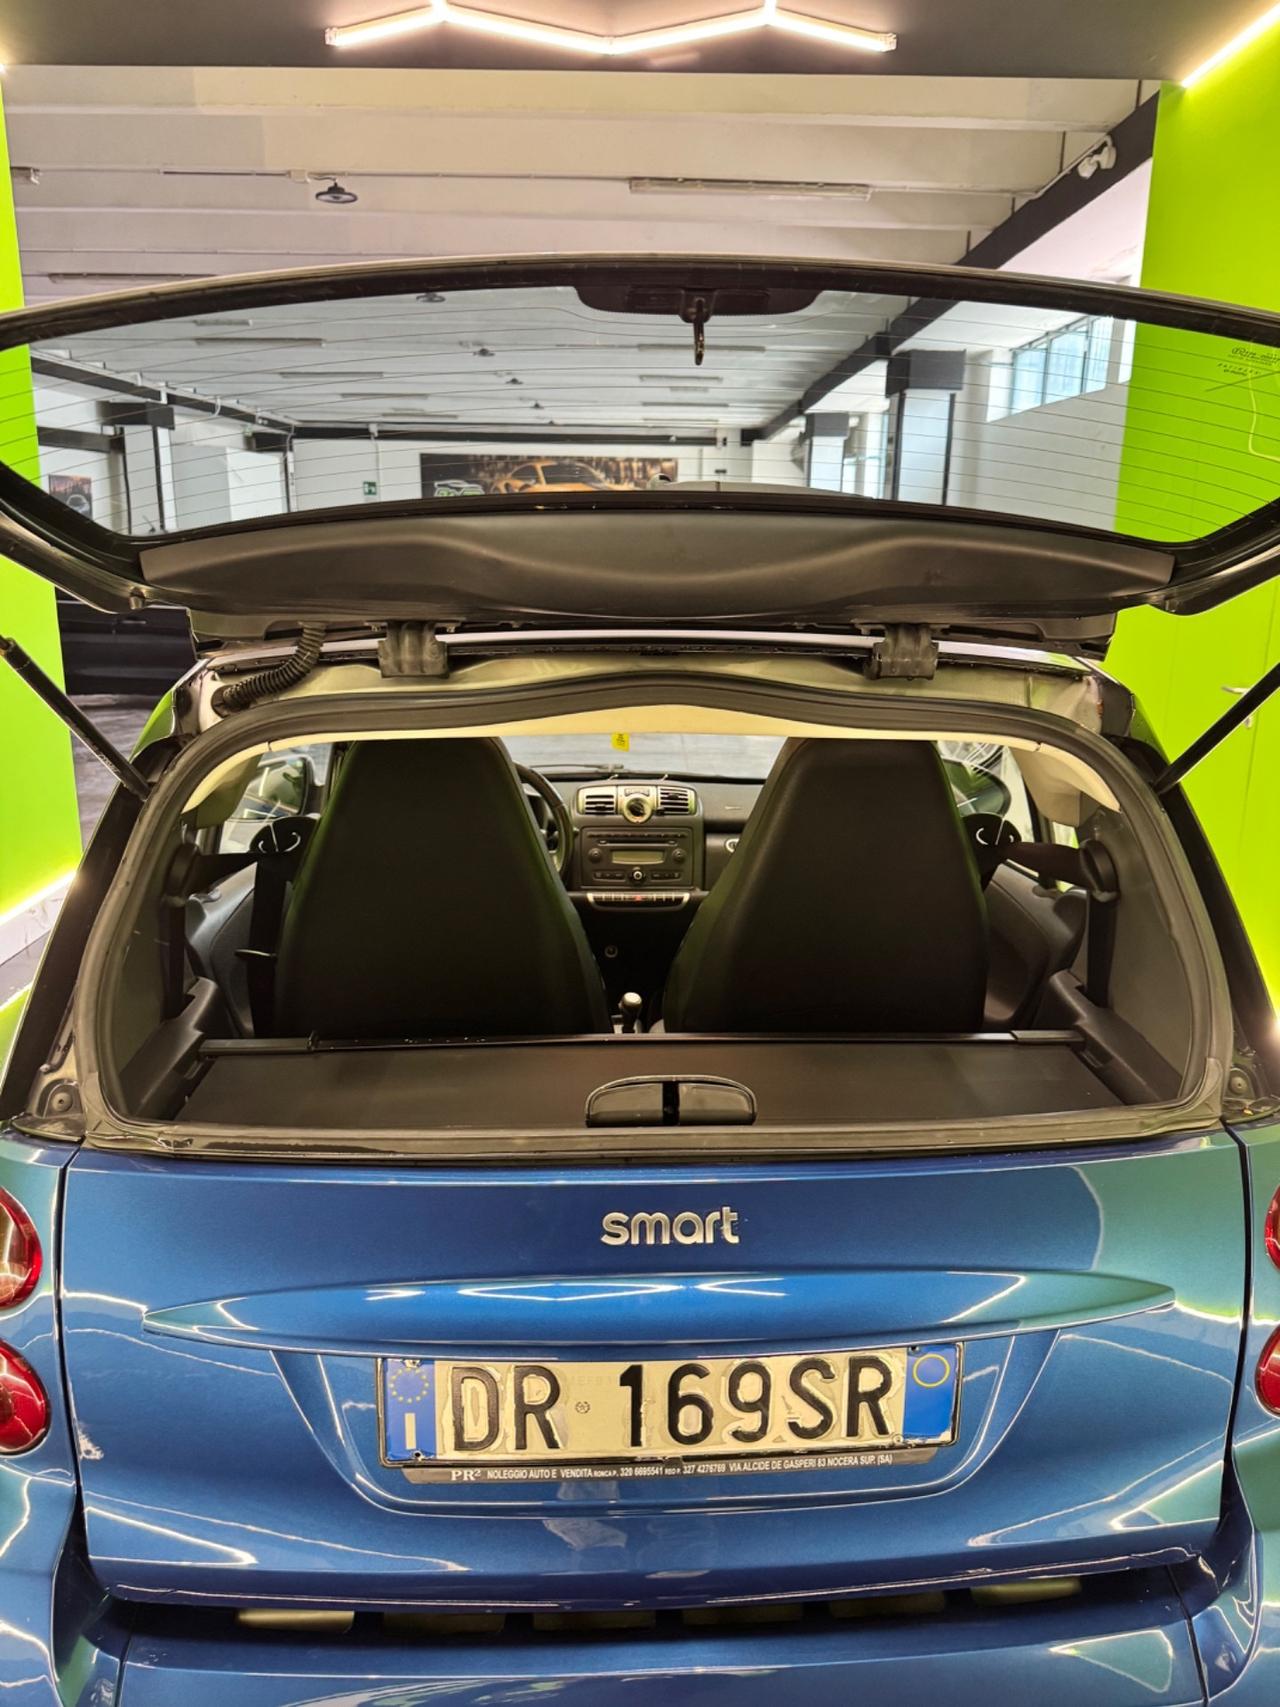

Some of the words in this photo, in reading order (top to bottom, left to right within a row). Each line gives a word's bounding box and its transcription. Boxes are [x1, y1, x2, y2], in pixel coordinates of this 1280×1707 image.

[601, 1206, 740, 1246] smart
[451, 1364, 560, 1452] DR
[487, 1469, 528, 1480] NOLEGGIO
[528, 1469, 551, 1479] AUTO
[551, 1468, 557, 1479] E
[560, 1468, 593, 1479] VENDITA
[728, 1462, 742, 1472] VIA
[742, 1460, 771, 1471] ALCIDE
[771, 1459, 782, 1470] DE
[783, 1458, 817, 1470] GASPERI
[827, 1456, 859, 1467] NOCERA
[860, 1454, 876, 1465] SUP.
[877, 1453, 893, 1466] (SA)
